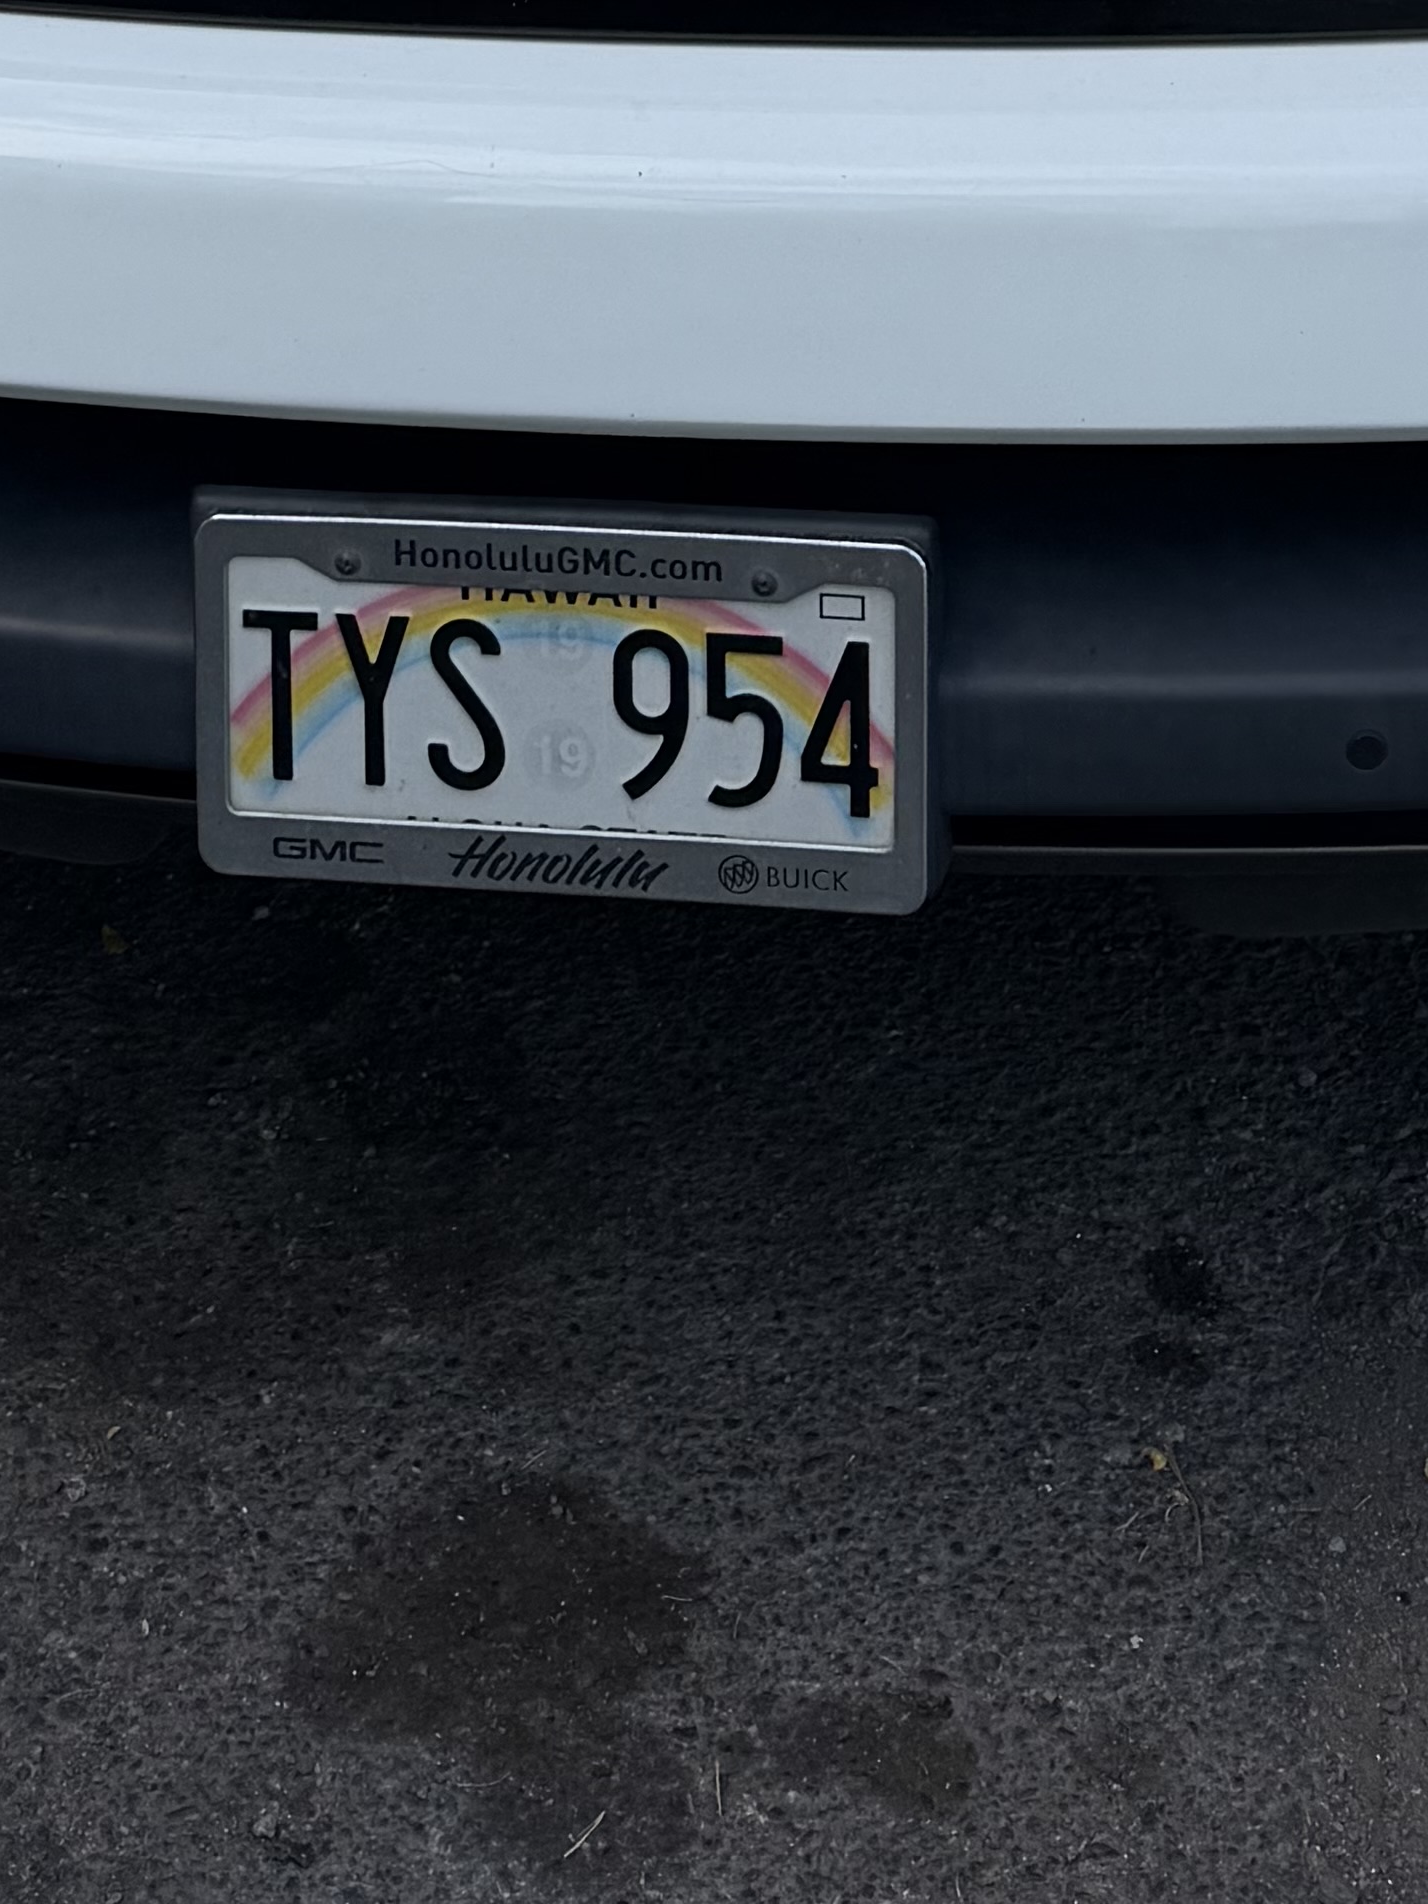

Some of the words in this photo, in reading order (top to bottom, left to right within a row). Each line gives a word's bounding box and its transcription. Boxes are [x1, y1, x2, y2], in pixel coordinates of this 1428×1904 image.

[393, 539, 723, 583] HonoluluGMC.com
[241, 609, 508, 791] TYS
[611, 629, 880, 819] 954
[272, 836, 385, 865] GMC
[448, 834, 670, 893] Honolulu
[766, 865, 850, 893] BUICK
